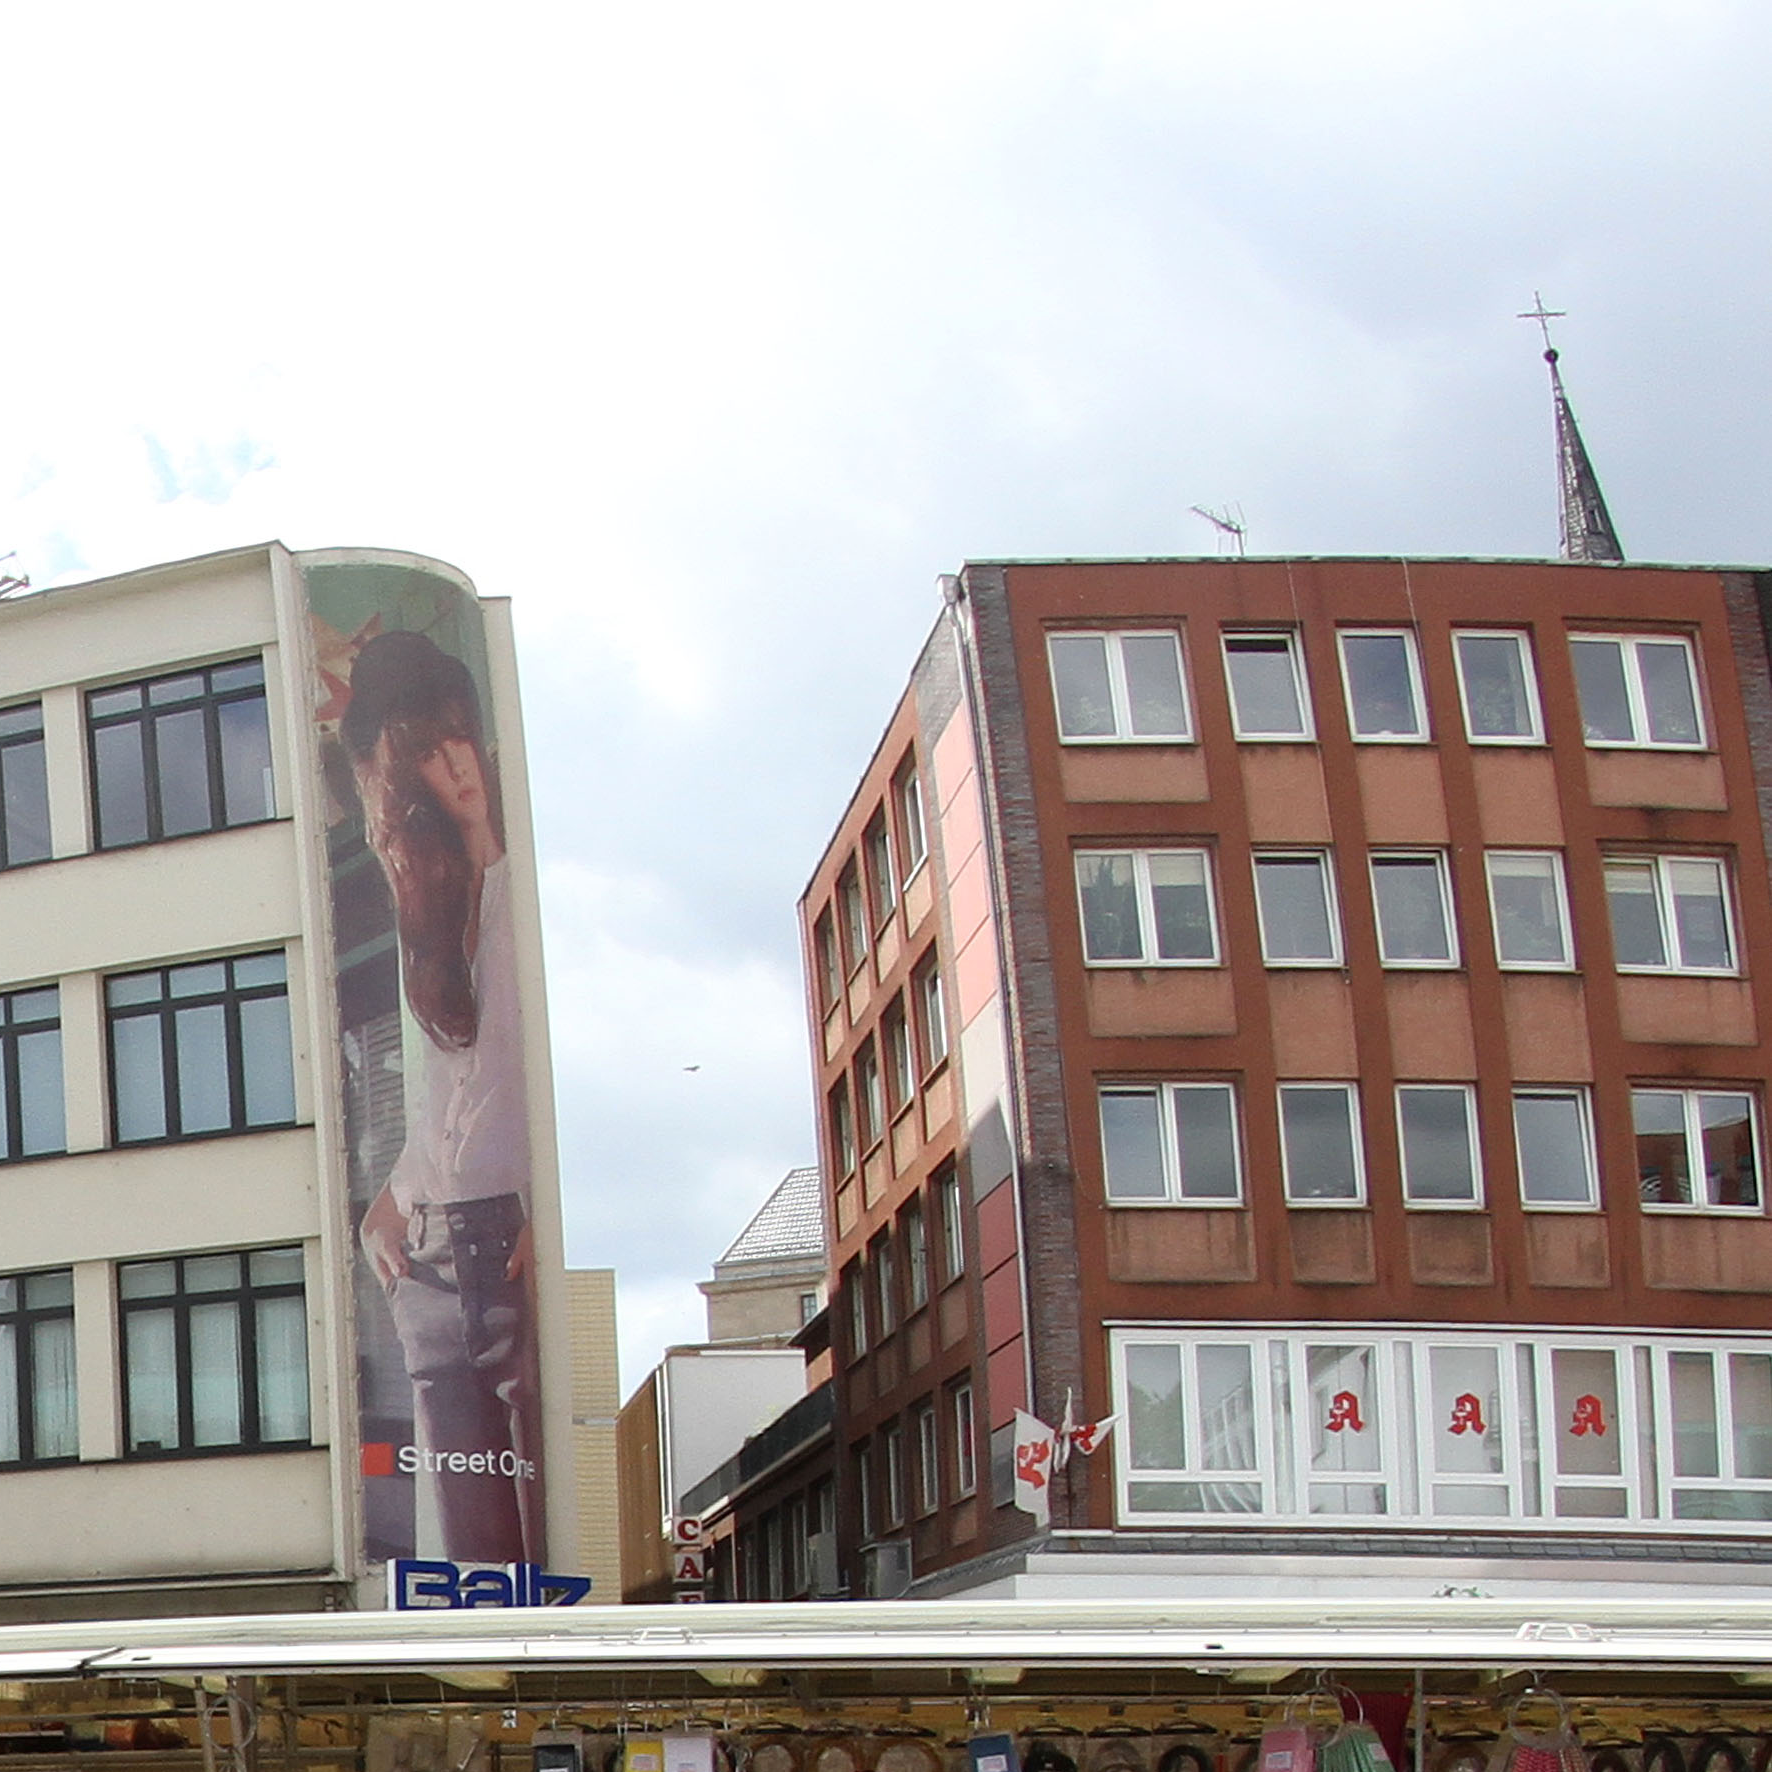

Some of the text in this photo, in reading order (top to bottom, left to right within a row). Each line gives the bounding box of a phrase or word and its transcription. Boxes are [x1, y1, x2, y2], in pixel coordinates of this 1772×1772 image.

[397, 1445, 536, 1481] Street One
[677, 1518, 705, 1604] CA
